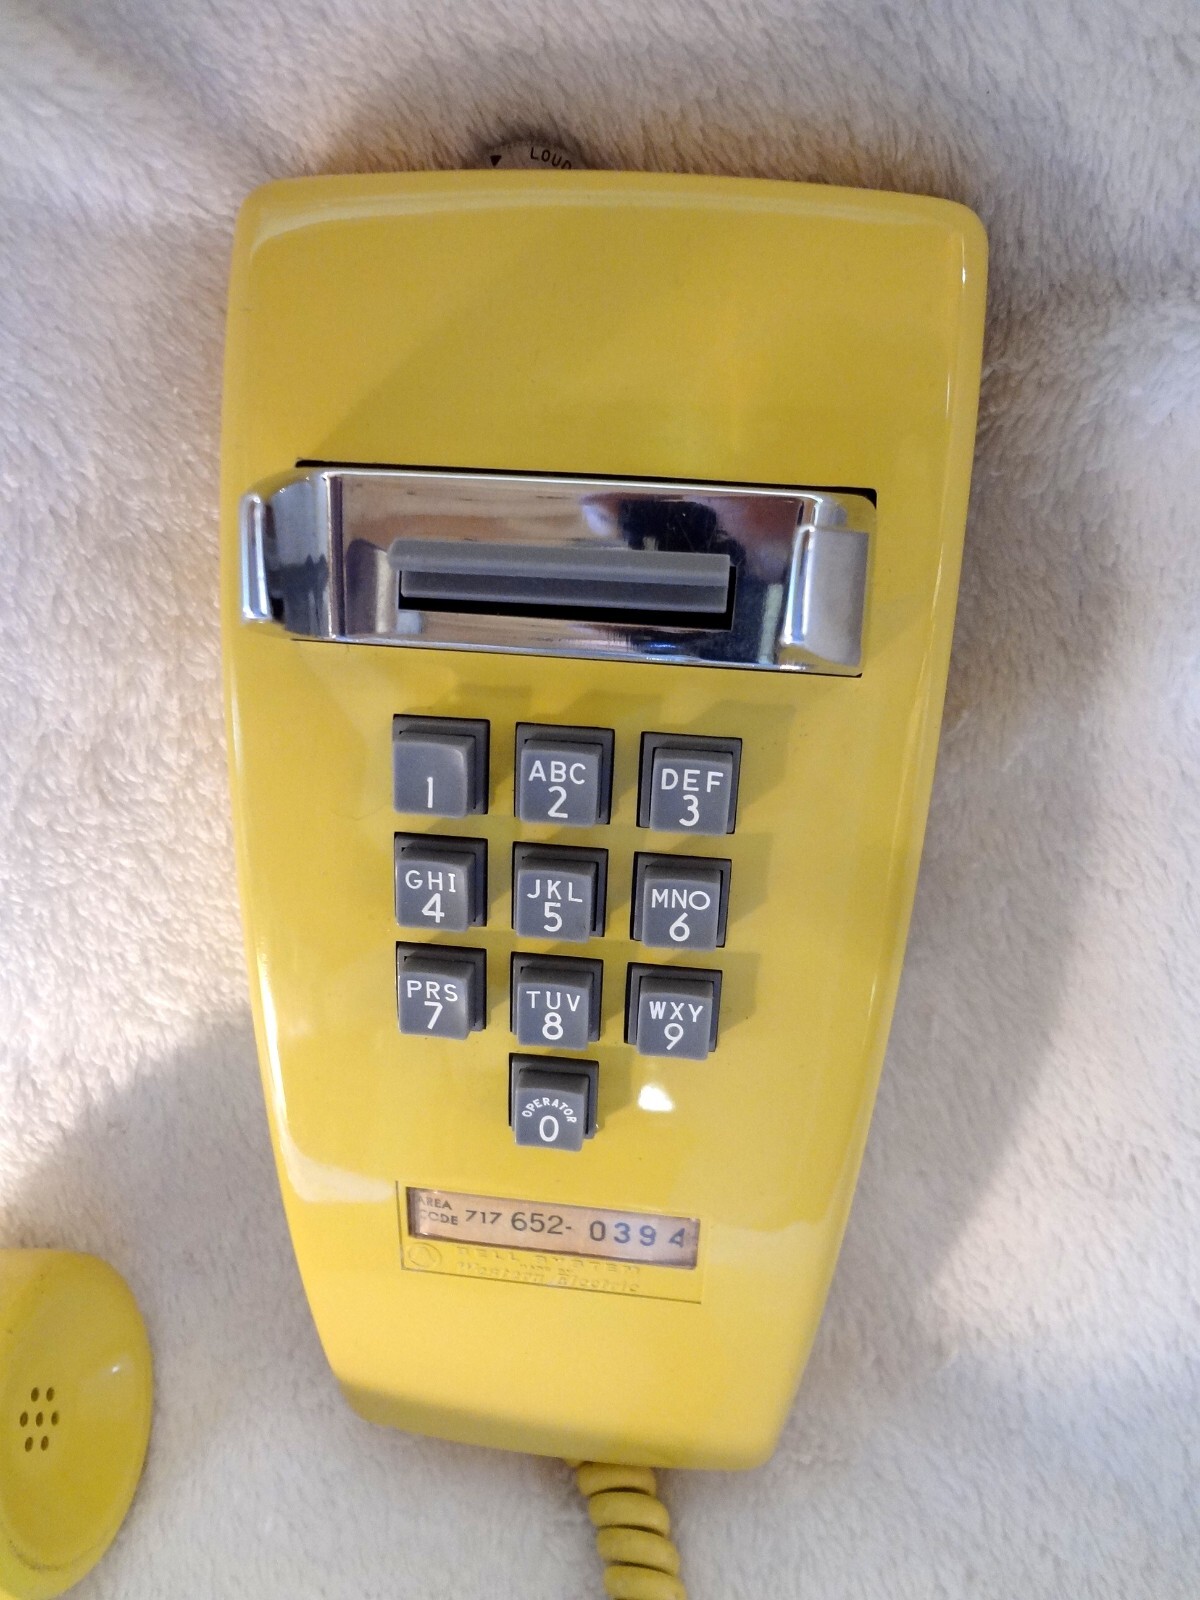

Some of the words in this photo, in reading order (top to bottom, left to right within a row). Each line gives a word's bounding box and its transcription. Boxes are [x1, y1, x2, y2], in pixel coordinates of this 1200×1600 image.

[528, 760, 586, 785] ABC
[660, 768, 724, 793] DEF
[427, 776, 434, 809] 1
[547, 786, 569, 819] 2
[678, 794, 700, 827] 3
[405, 869, 457, 893] GHI
[526, 879, 583, 903] JKL
[421, 893, 445, 923] 4
[651, 888, 711, 911] MNO
[543, 902, 563, 932] 5
[669, 912, 690, 942] 6
[407, 979, 459, 1002] PRS
[526, 990, 581, 1013] TUV
[424, 1001, 443, 1030] 7
[649, 1000, 704, 1023] WXY
[542, 1012, 564, 1040] 8
[664, 1023, 684, 1050] 9
[521, 1097, 577, 1123] OPERATOR
[539, 1115, 559, 1142] 0
[417, 1195, 453, 1211] AREA
[465, 1209, 502, 1224] 717
